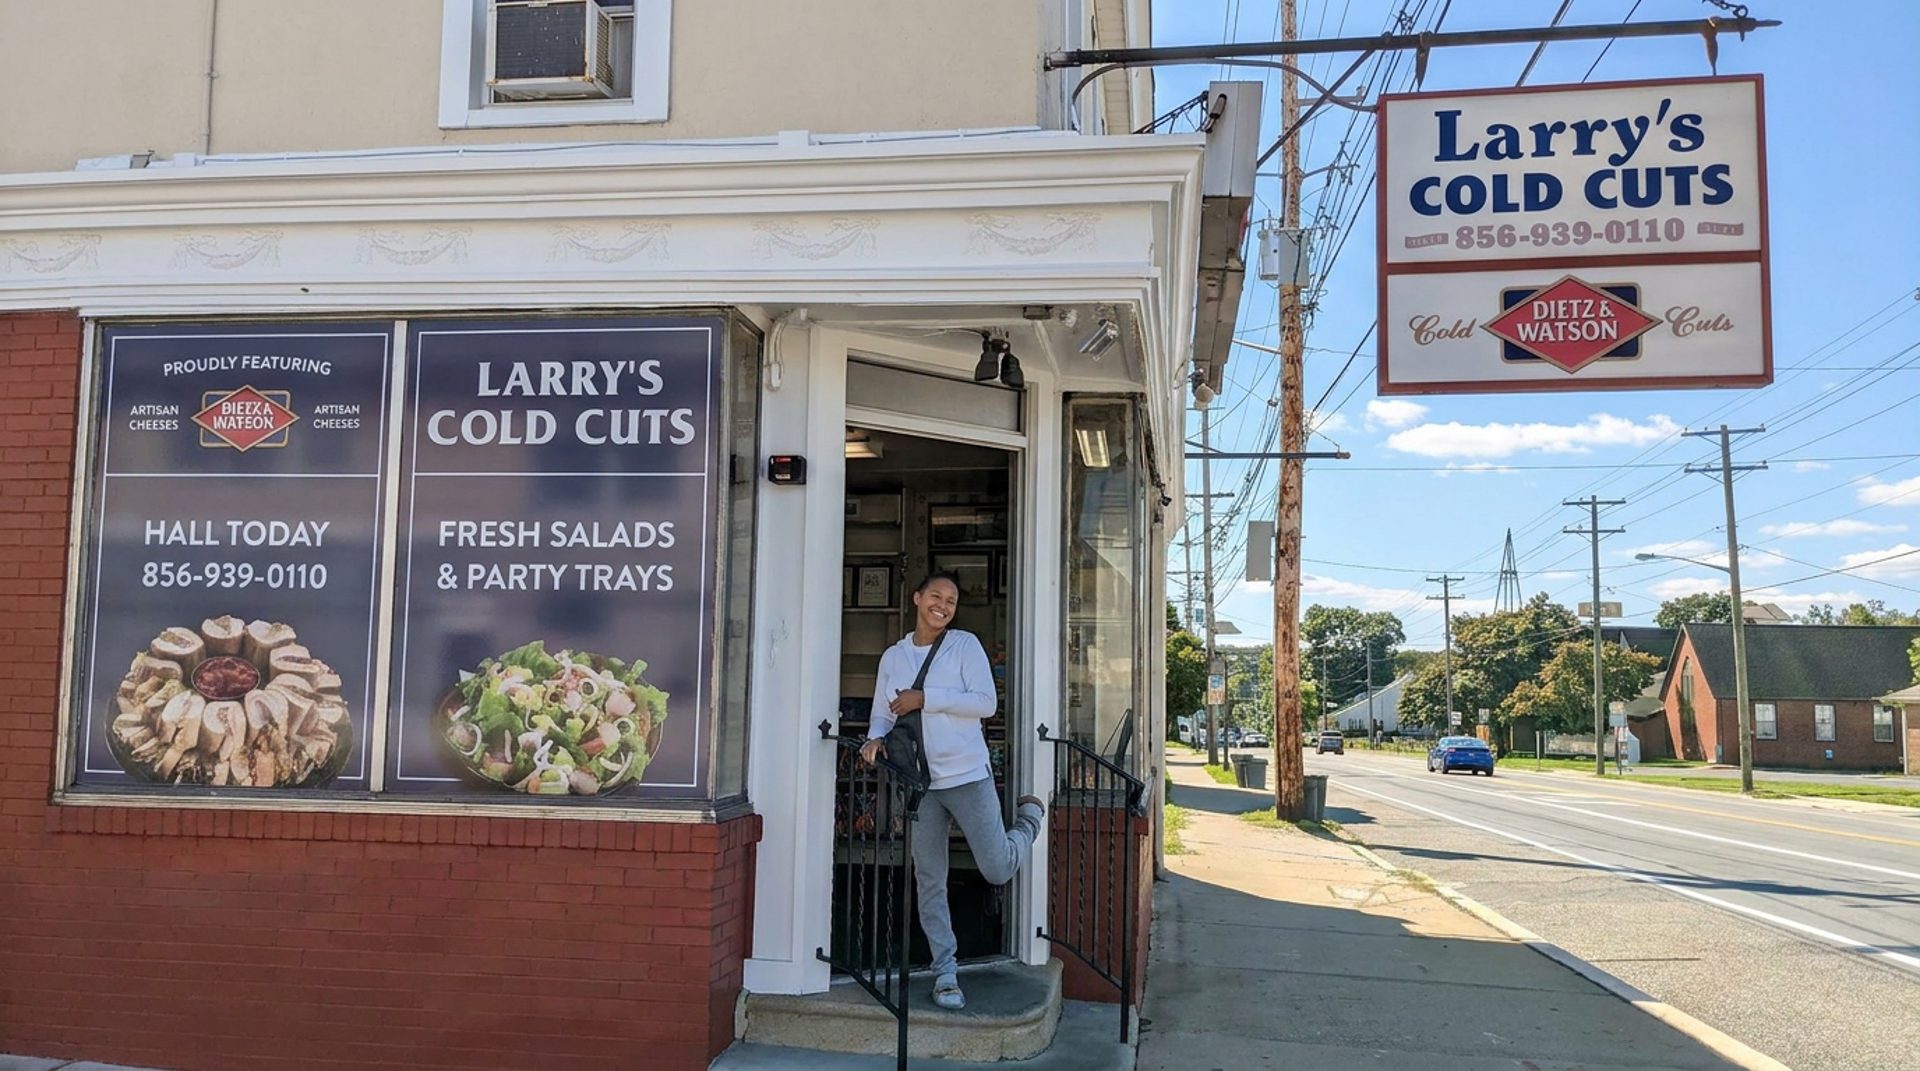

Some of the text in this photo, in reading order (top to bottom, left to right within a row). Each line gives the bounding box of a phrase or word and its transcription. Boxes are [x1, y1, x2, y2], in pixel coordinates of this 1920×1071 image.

[1434, 98, 1705, 166] Larry's
[1410, 164, 1733, 216] COLD CUTS
[1456, 217, 1685, 250] 856-939-0110
[1533, 299, 1615, 320] DIETZ &
[1665, 306, 1734, 337] Cuts
[1409, 315, 1476, 345] Cold
[1516, 320, 1618, 342] WATSON
[164, 356, 331, 376] PROUDLY FEATURING
[478, 360, 663, 396] LARRY'S
[131, 405, 178, 415] ARTISAN
[314, 419, 359, 428] CHEESES
[130, 420, 178, 430] CHEESES
[428, 409, 695, 445] COLD CUTS
[145, 520, 330, 546] HALL TODAY
[440, 521, 674, 548] FRESH SALADS
[143, 562, 327, 589] 856-939-0110
[438, 564, 673, 591] & PARTY TRAYS
